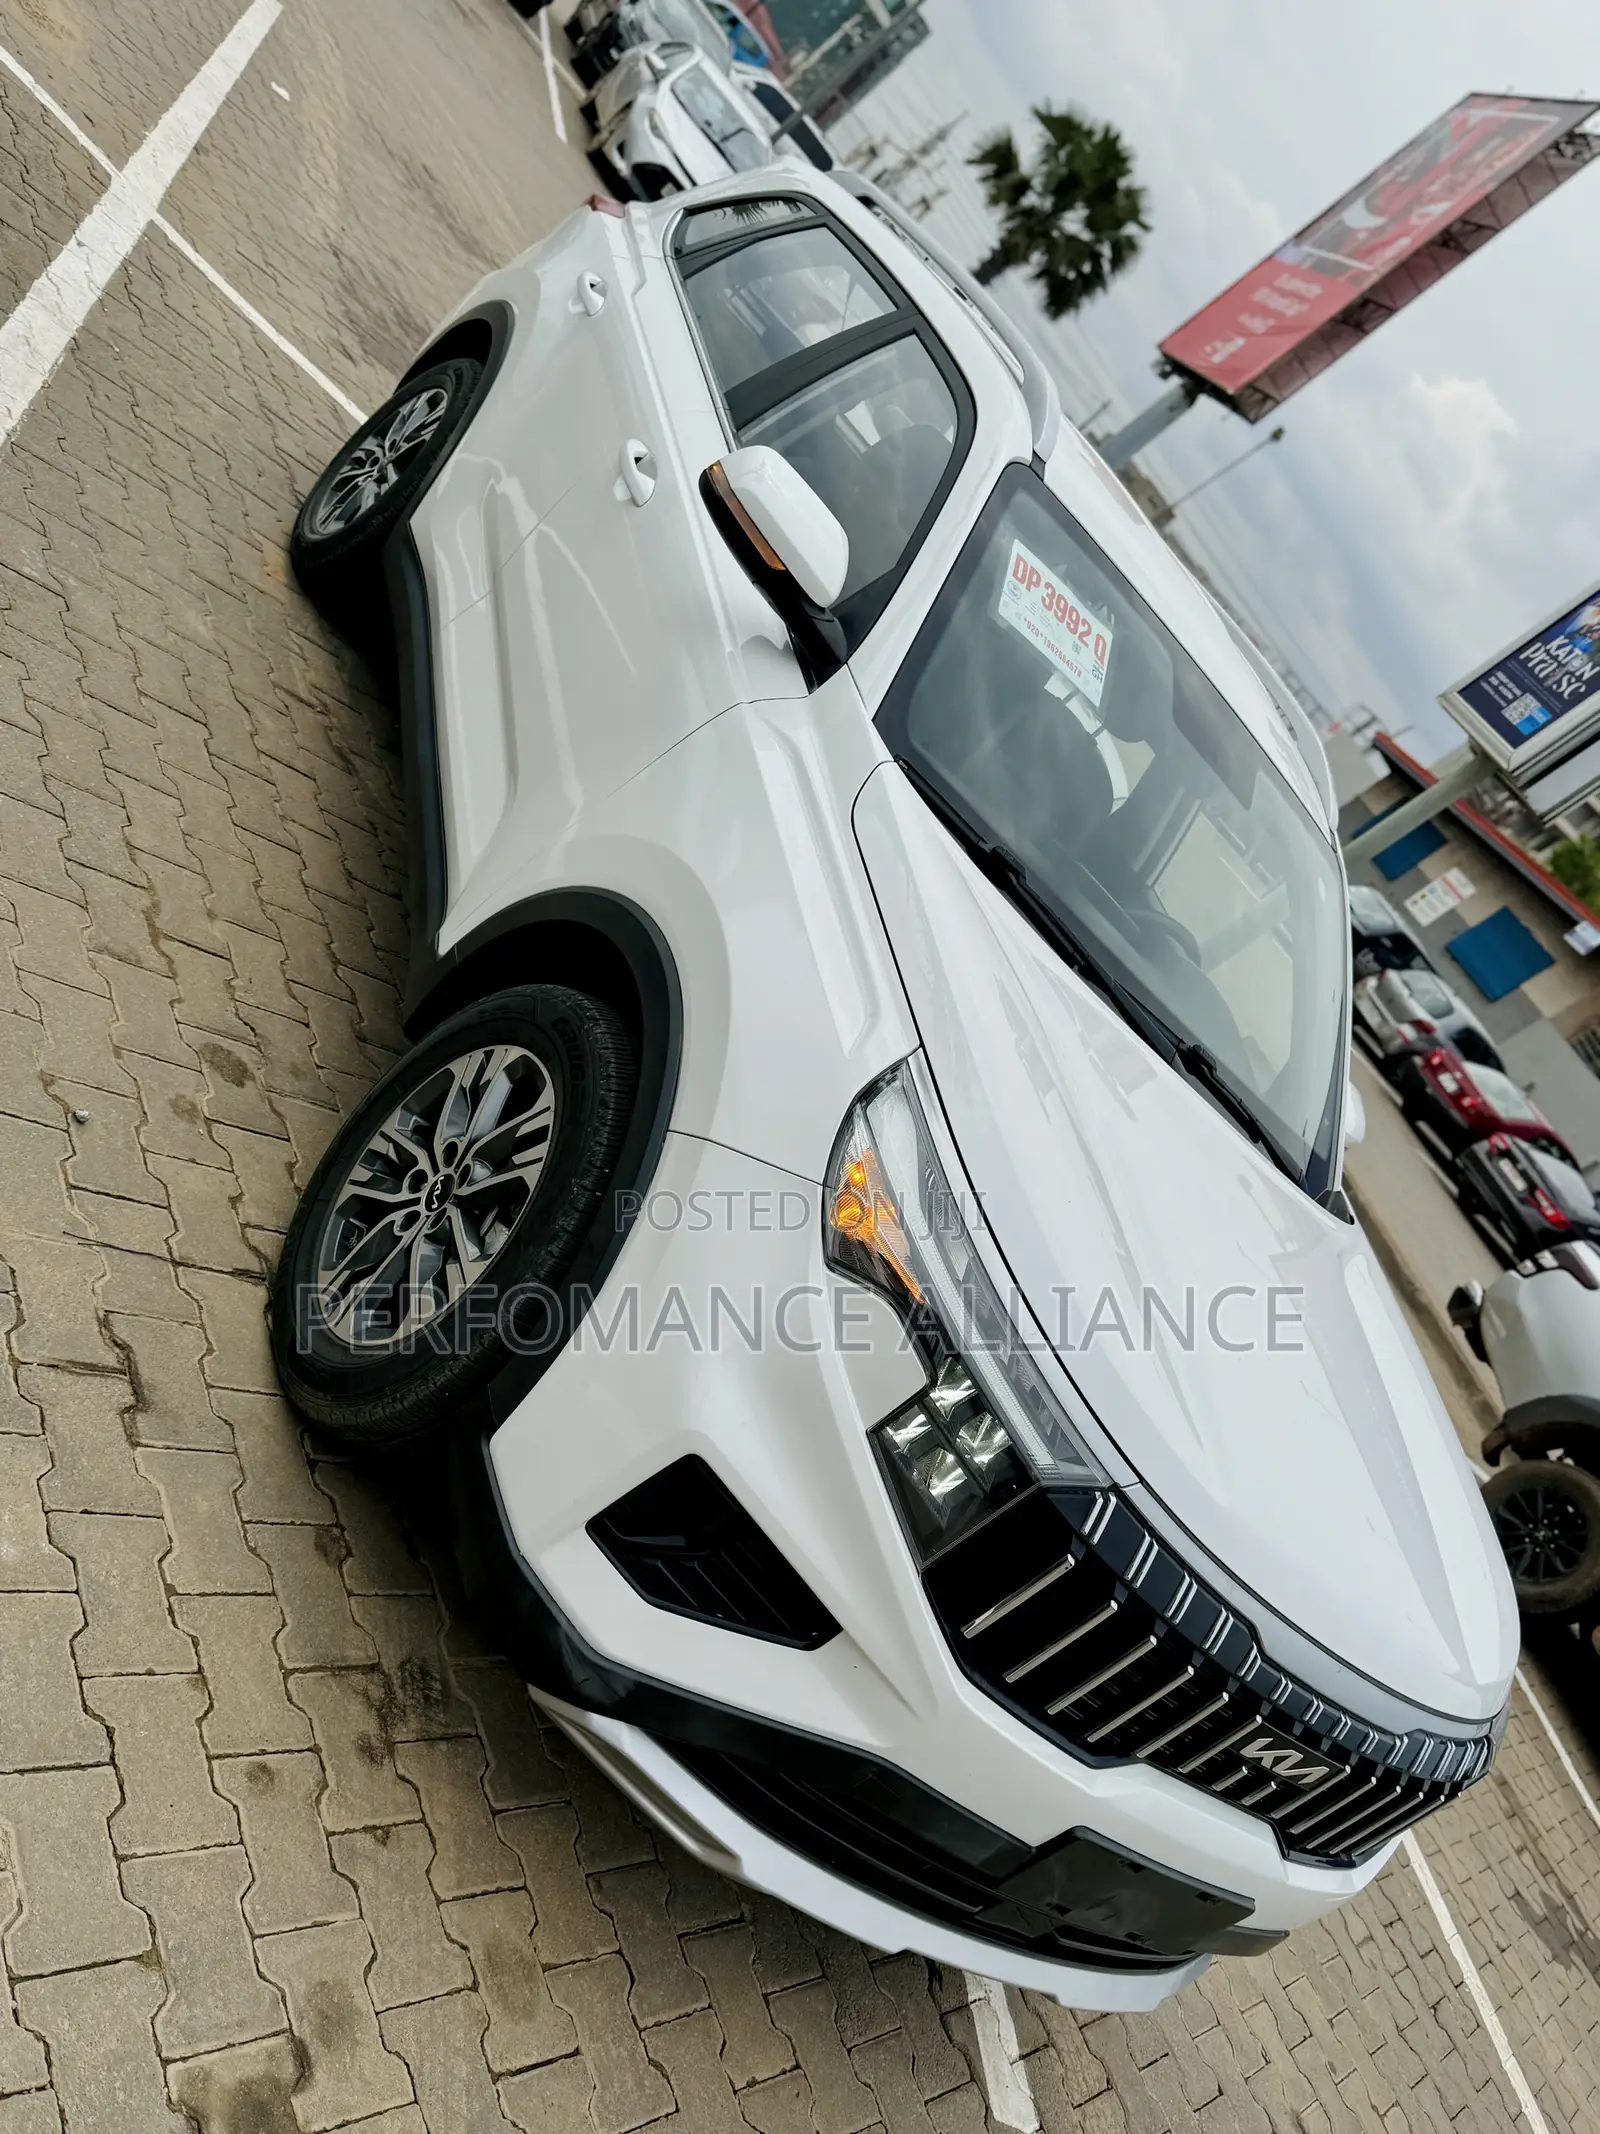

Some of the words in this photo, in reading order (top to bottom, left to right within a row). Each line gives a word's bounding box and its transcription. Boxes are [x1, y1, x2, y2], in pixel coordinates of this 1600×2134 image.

[1012, 552, 1042, 593] DP
[1041, 581, 1092, 648] 3992
[1091, 669, 1103, 684] GH
[1239, 1737, 1331, 1785] KIA
